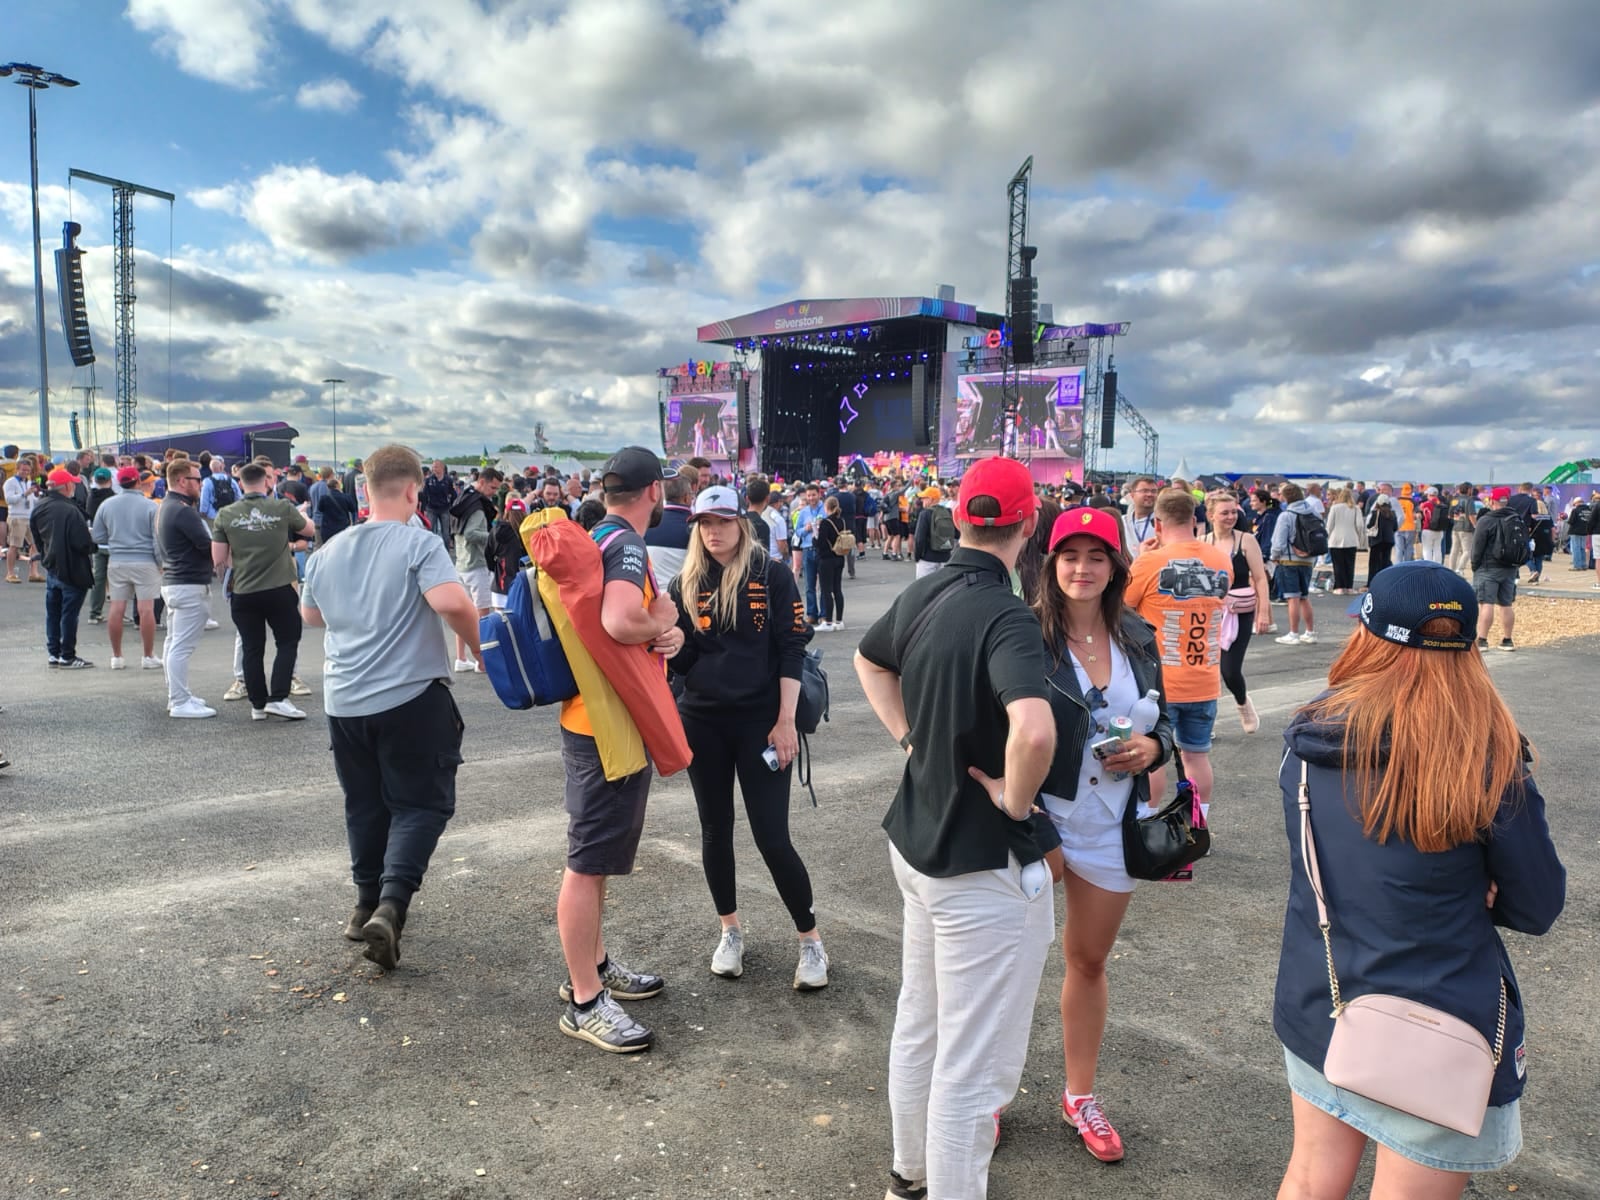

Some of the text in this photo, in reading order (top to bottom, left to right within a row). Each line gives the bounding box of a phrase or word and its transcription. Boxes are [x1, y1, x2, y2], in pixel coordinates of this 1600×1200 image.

[775, 315, 823, 329] Silverstone
[680, 358, 715, 378] ebay
[1186, 612, 1207, 666] 2025
